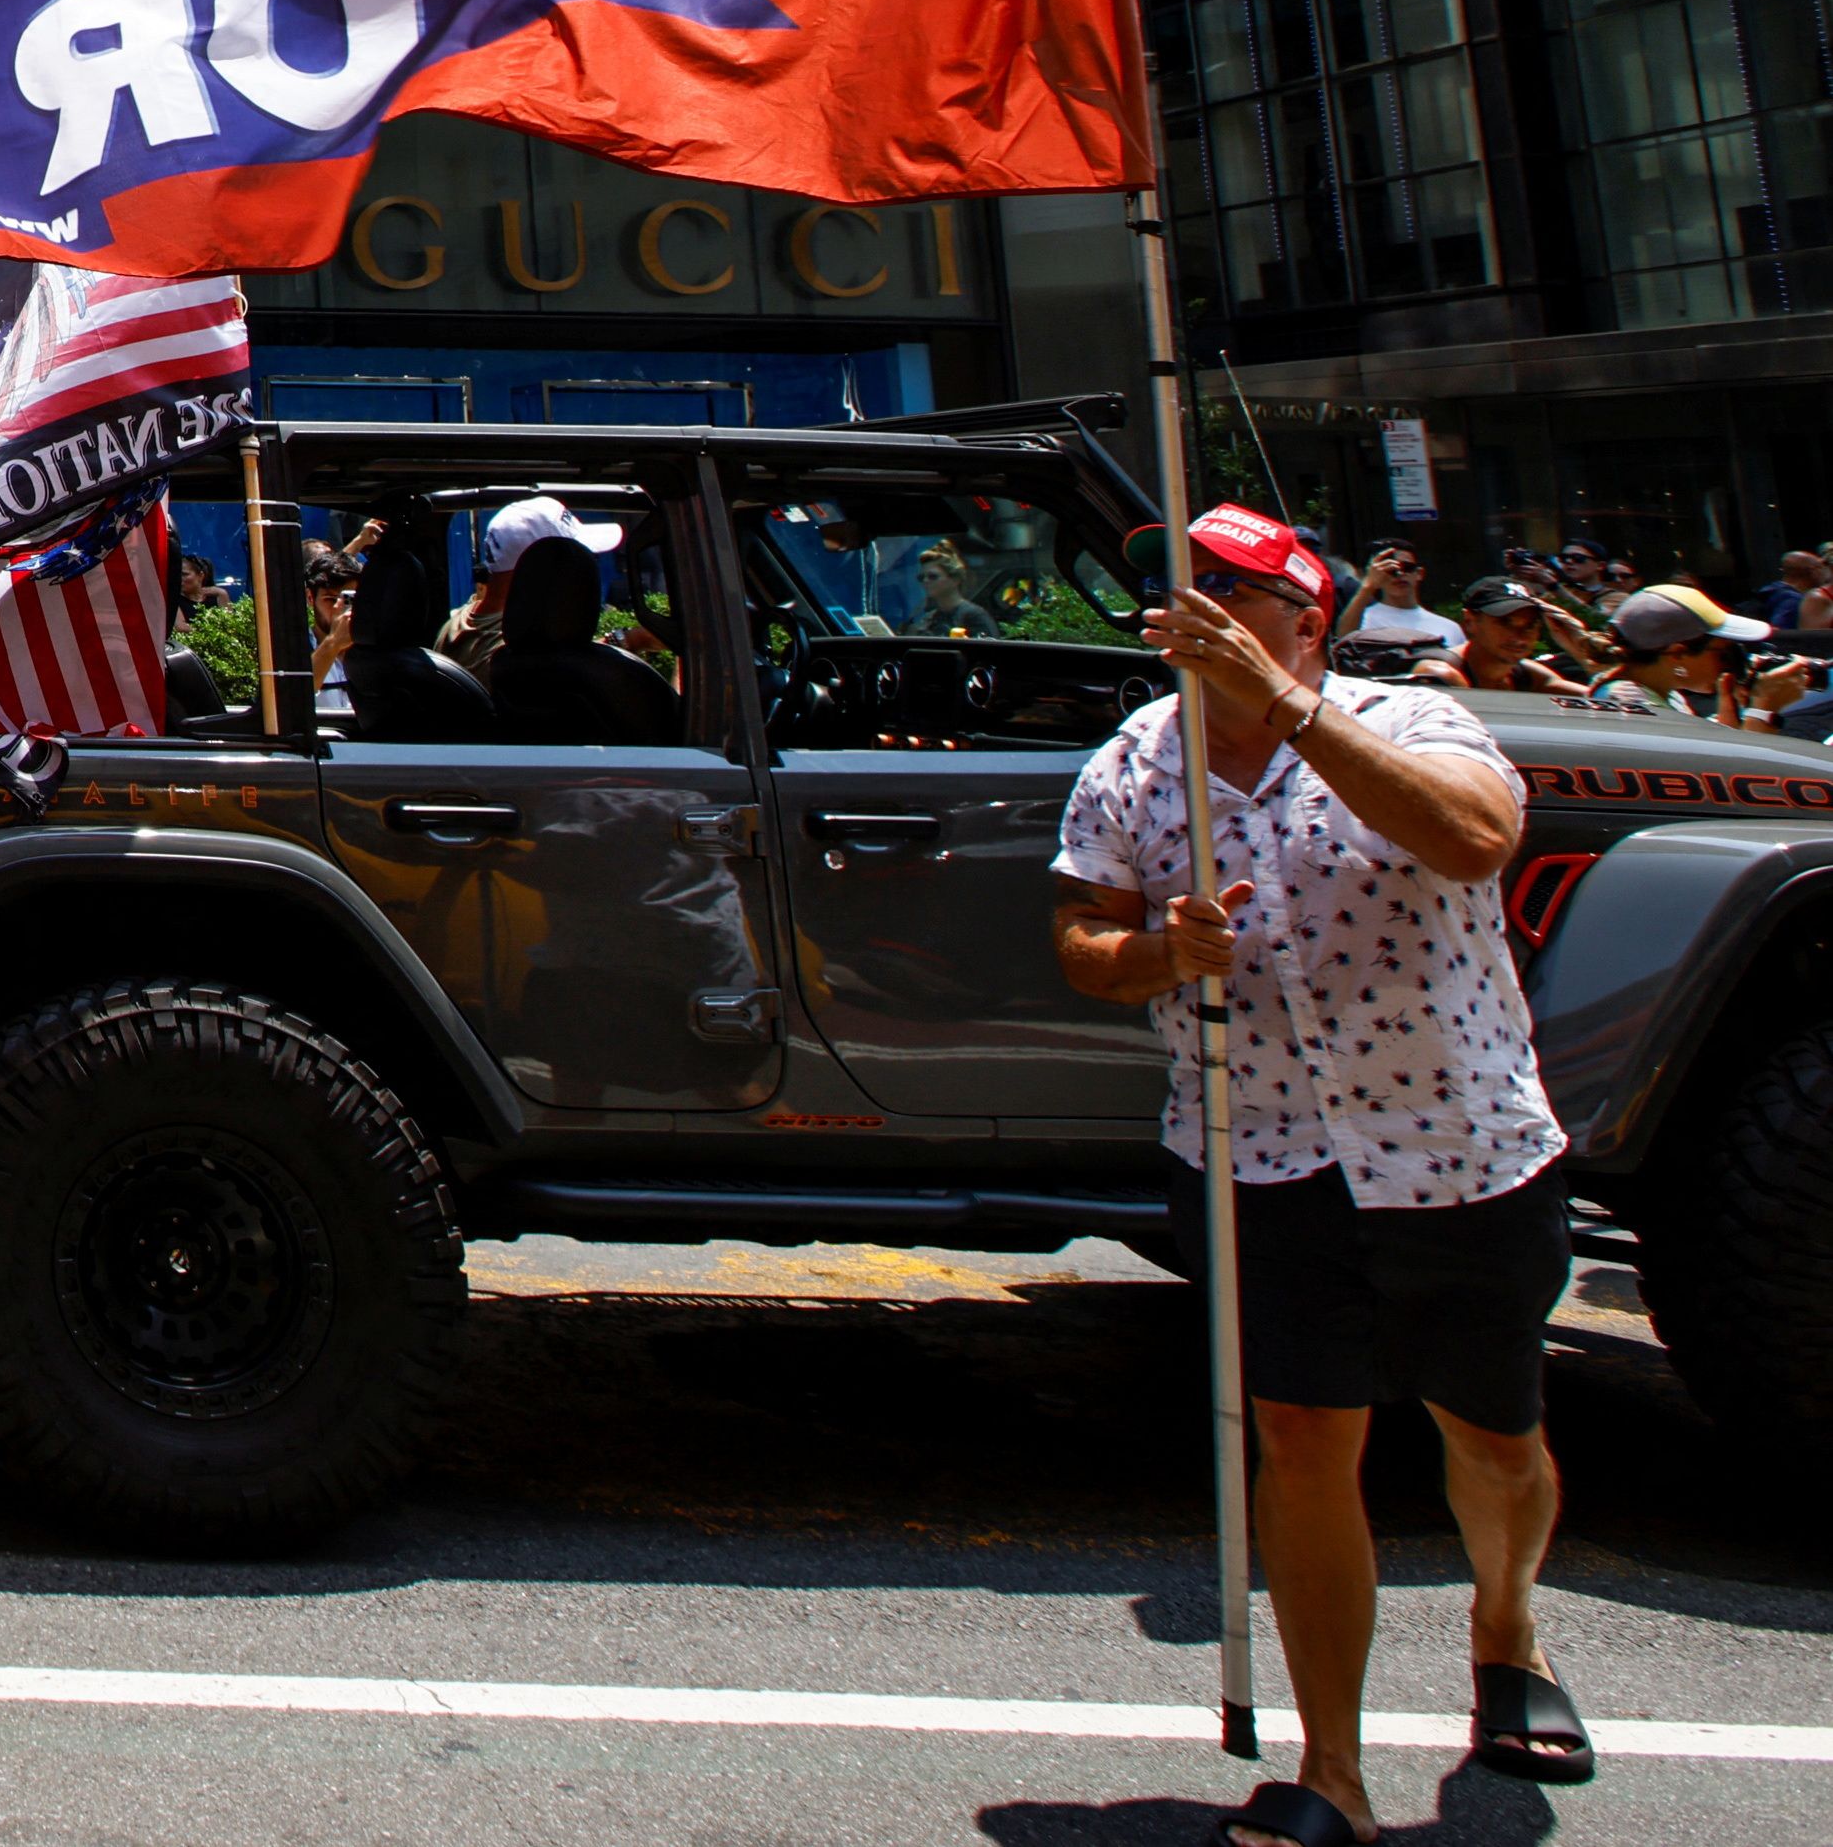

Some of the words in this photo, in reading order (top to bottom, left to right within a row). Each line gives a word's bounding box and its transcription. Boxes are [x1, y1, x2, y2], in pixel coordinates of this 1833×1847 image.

[352, 195, 961, 299] GUCCI
[1203, 522, 1264, 548] AGAIN
[764, 1113, 885, 1130] NITTO
